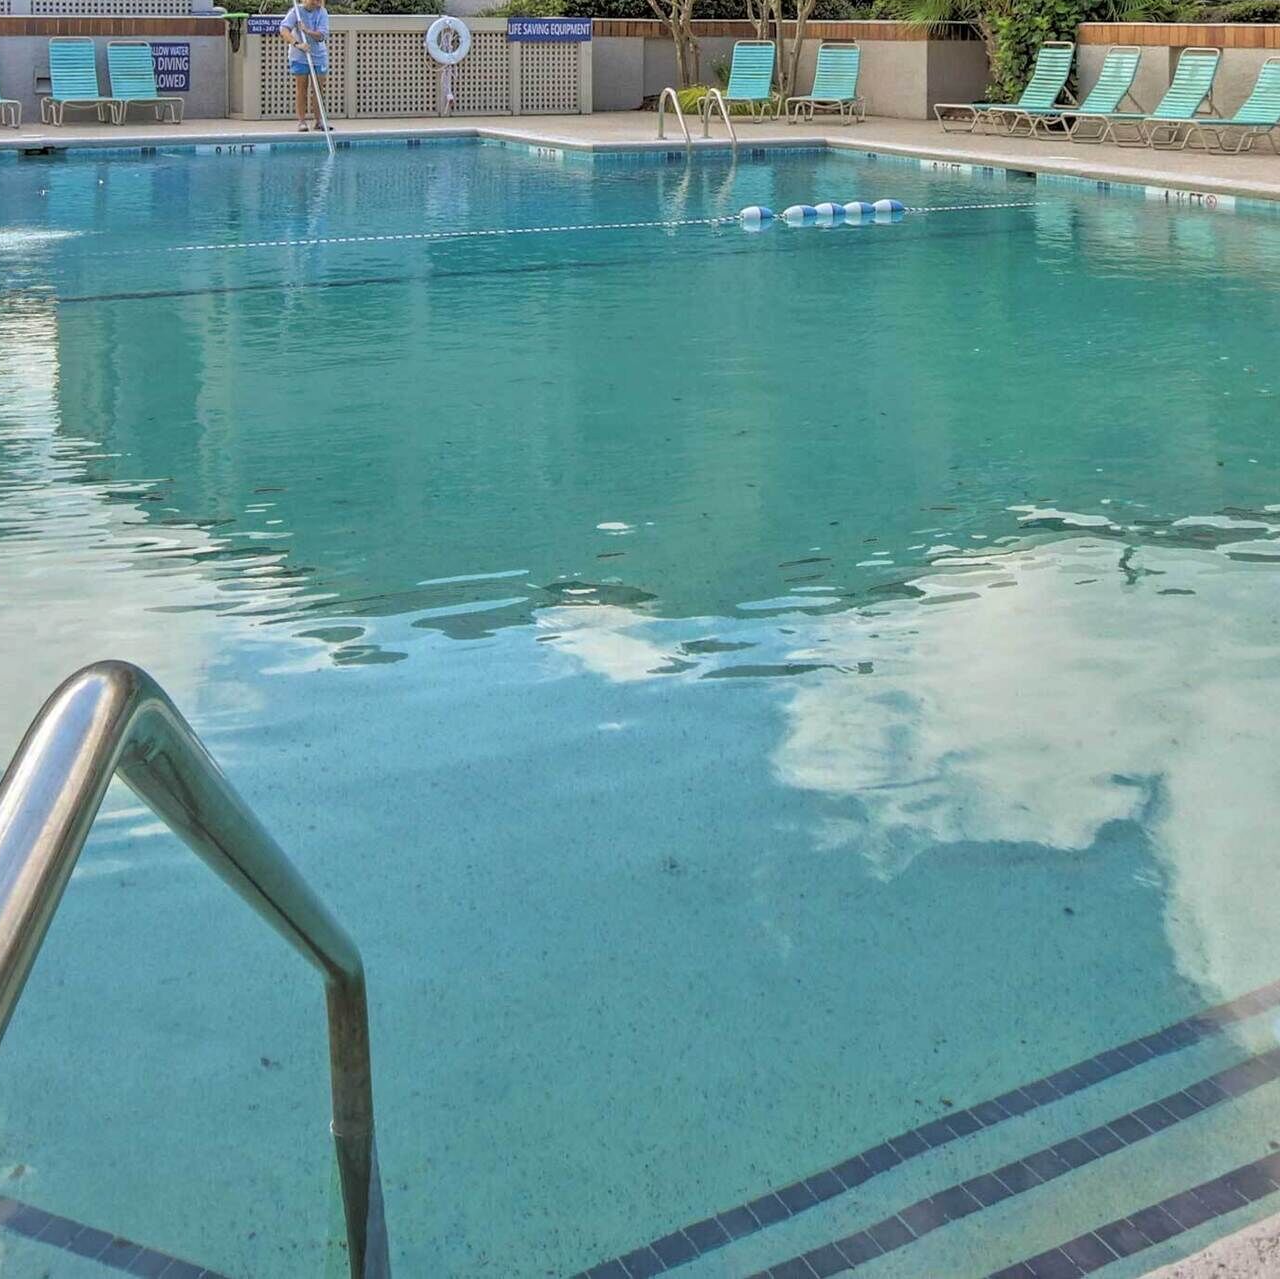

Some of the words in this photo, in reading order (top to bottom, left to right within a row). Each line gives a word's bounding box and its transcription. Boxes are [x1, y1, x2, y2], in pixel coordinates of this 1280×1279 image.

[508, 23, 522, 35] LIFE
[523, 23, 549, 36] SAVING
[550, 23, 590, 36] EQUIPMENT
[169, 46, 189, 56] WATER
[157, 56, 189, 71] DIVING
